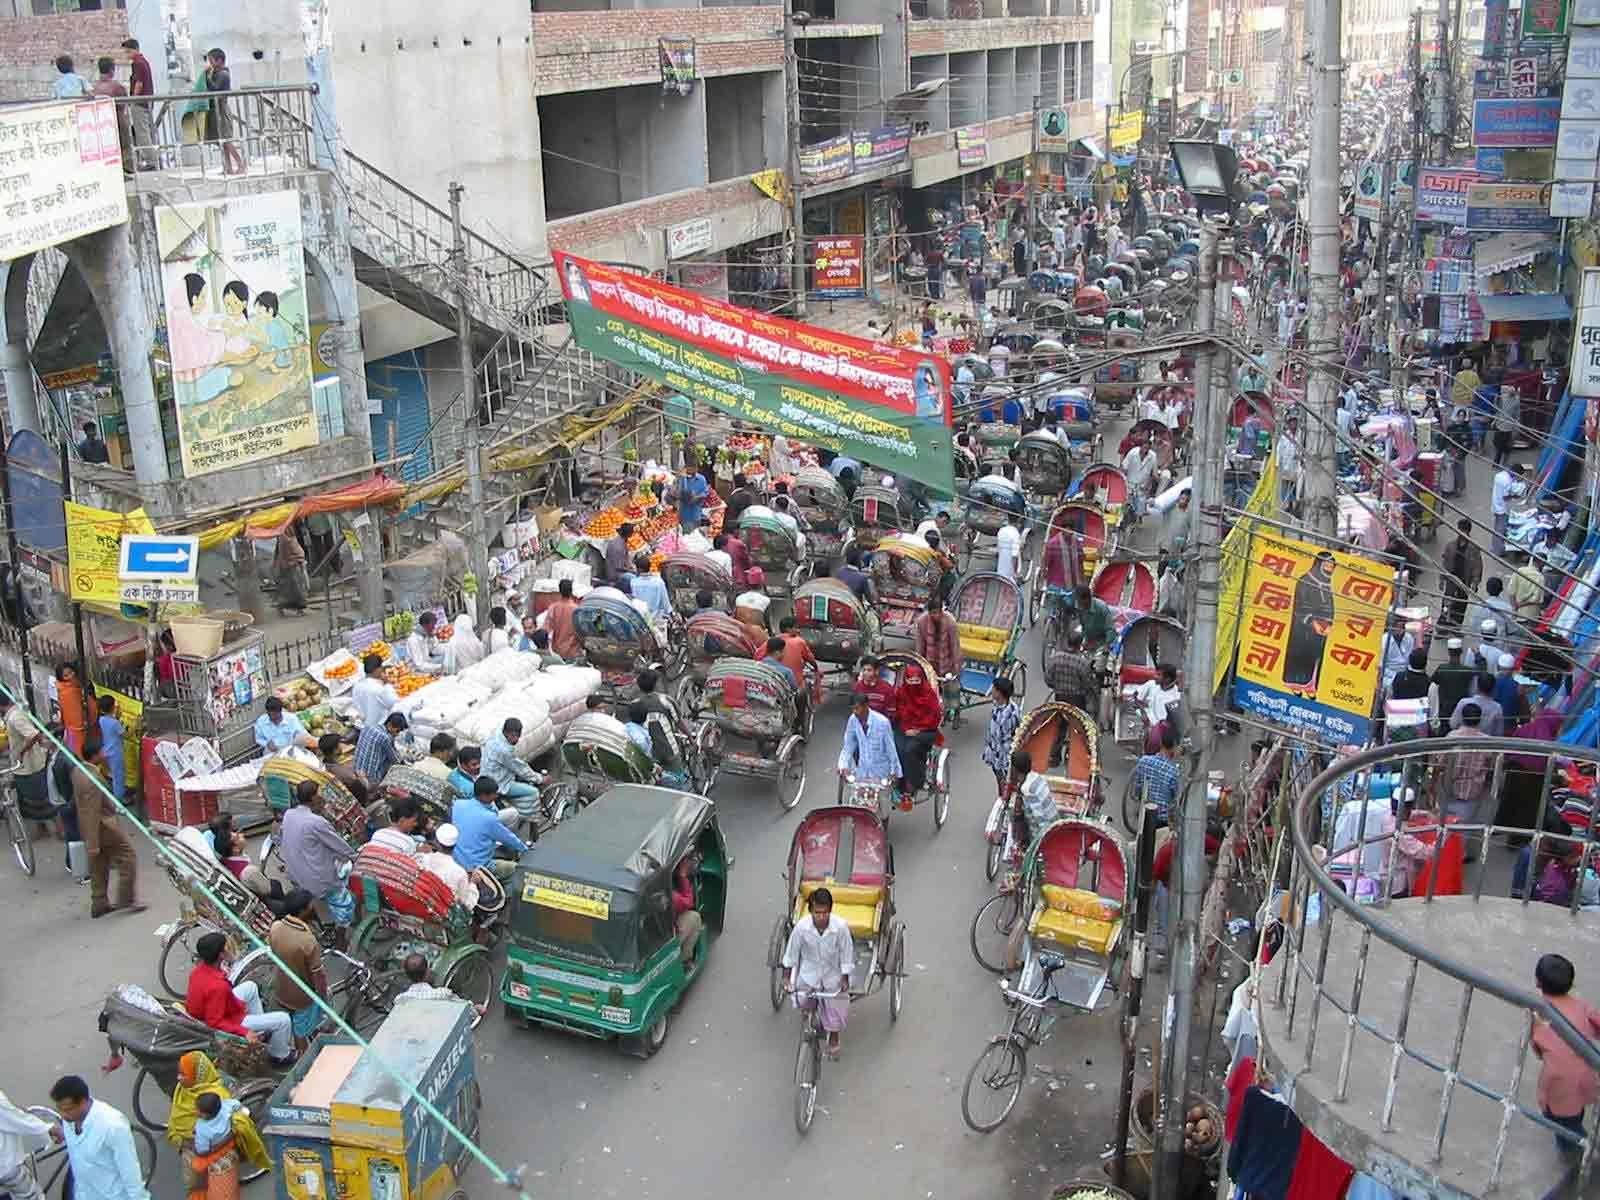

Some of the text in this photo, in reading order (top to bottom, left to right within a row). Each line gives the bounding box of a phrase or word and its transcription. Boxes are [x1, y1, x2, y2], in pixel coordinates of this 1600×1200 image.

[123, 583, 195, 601] এক দিকে চলাচল
